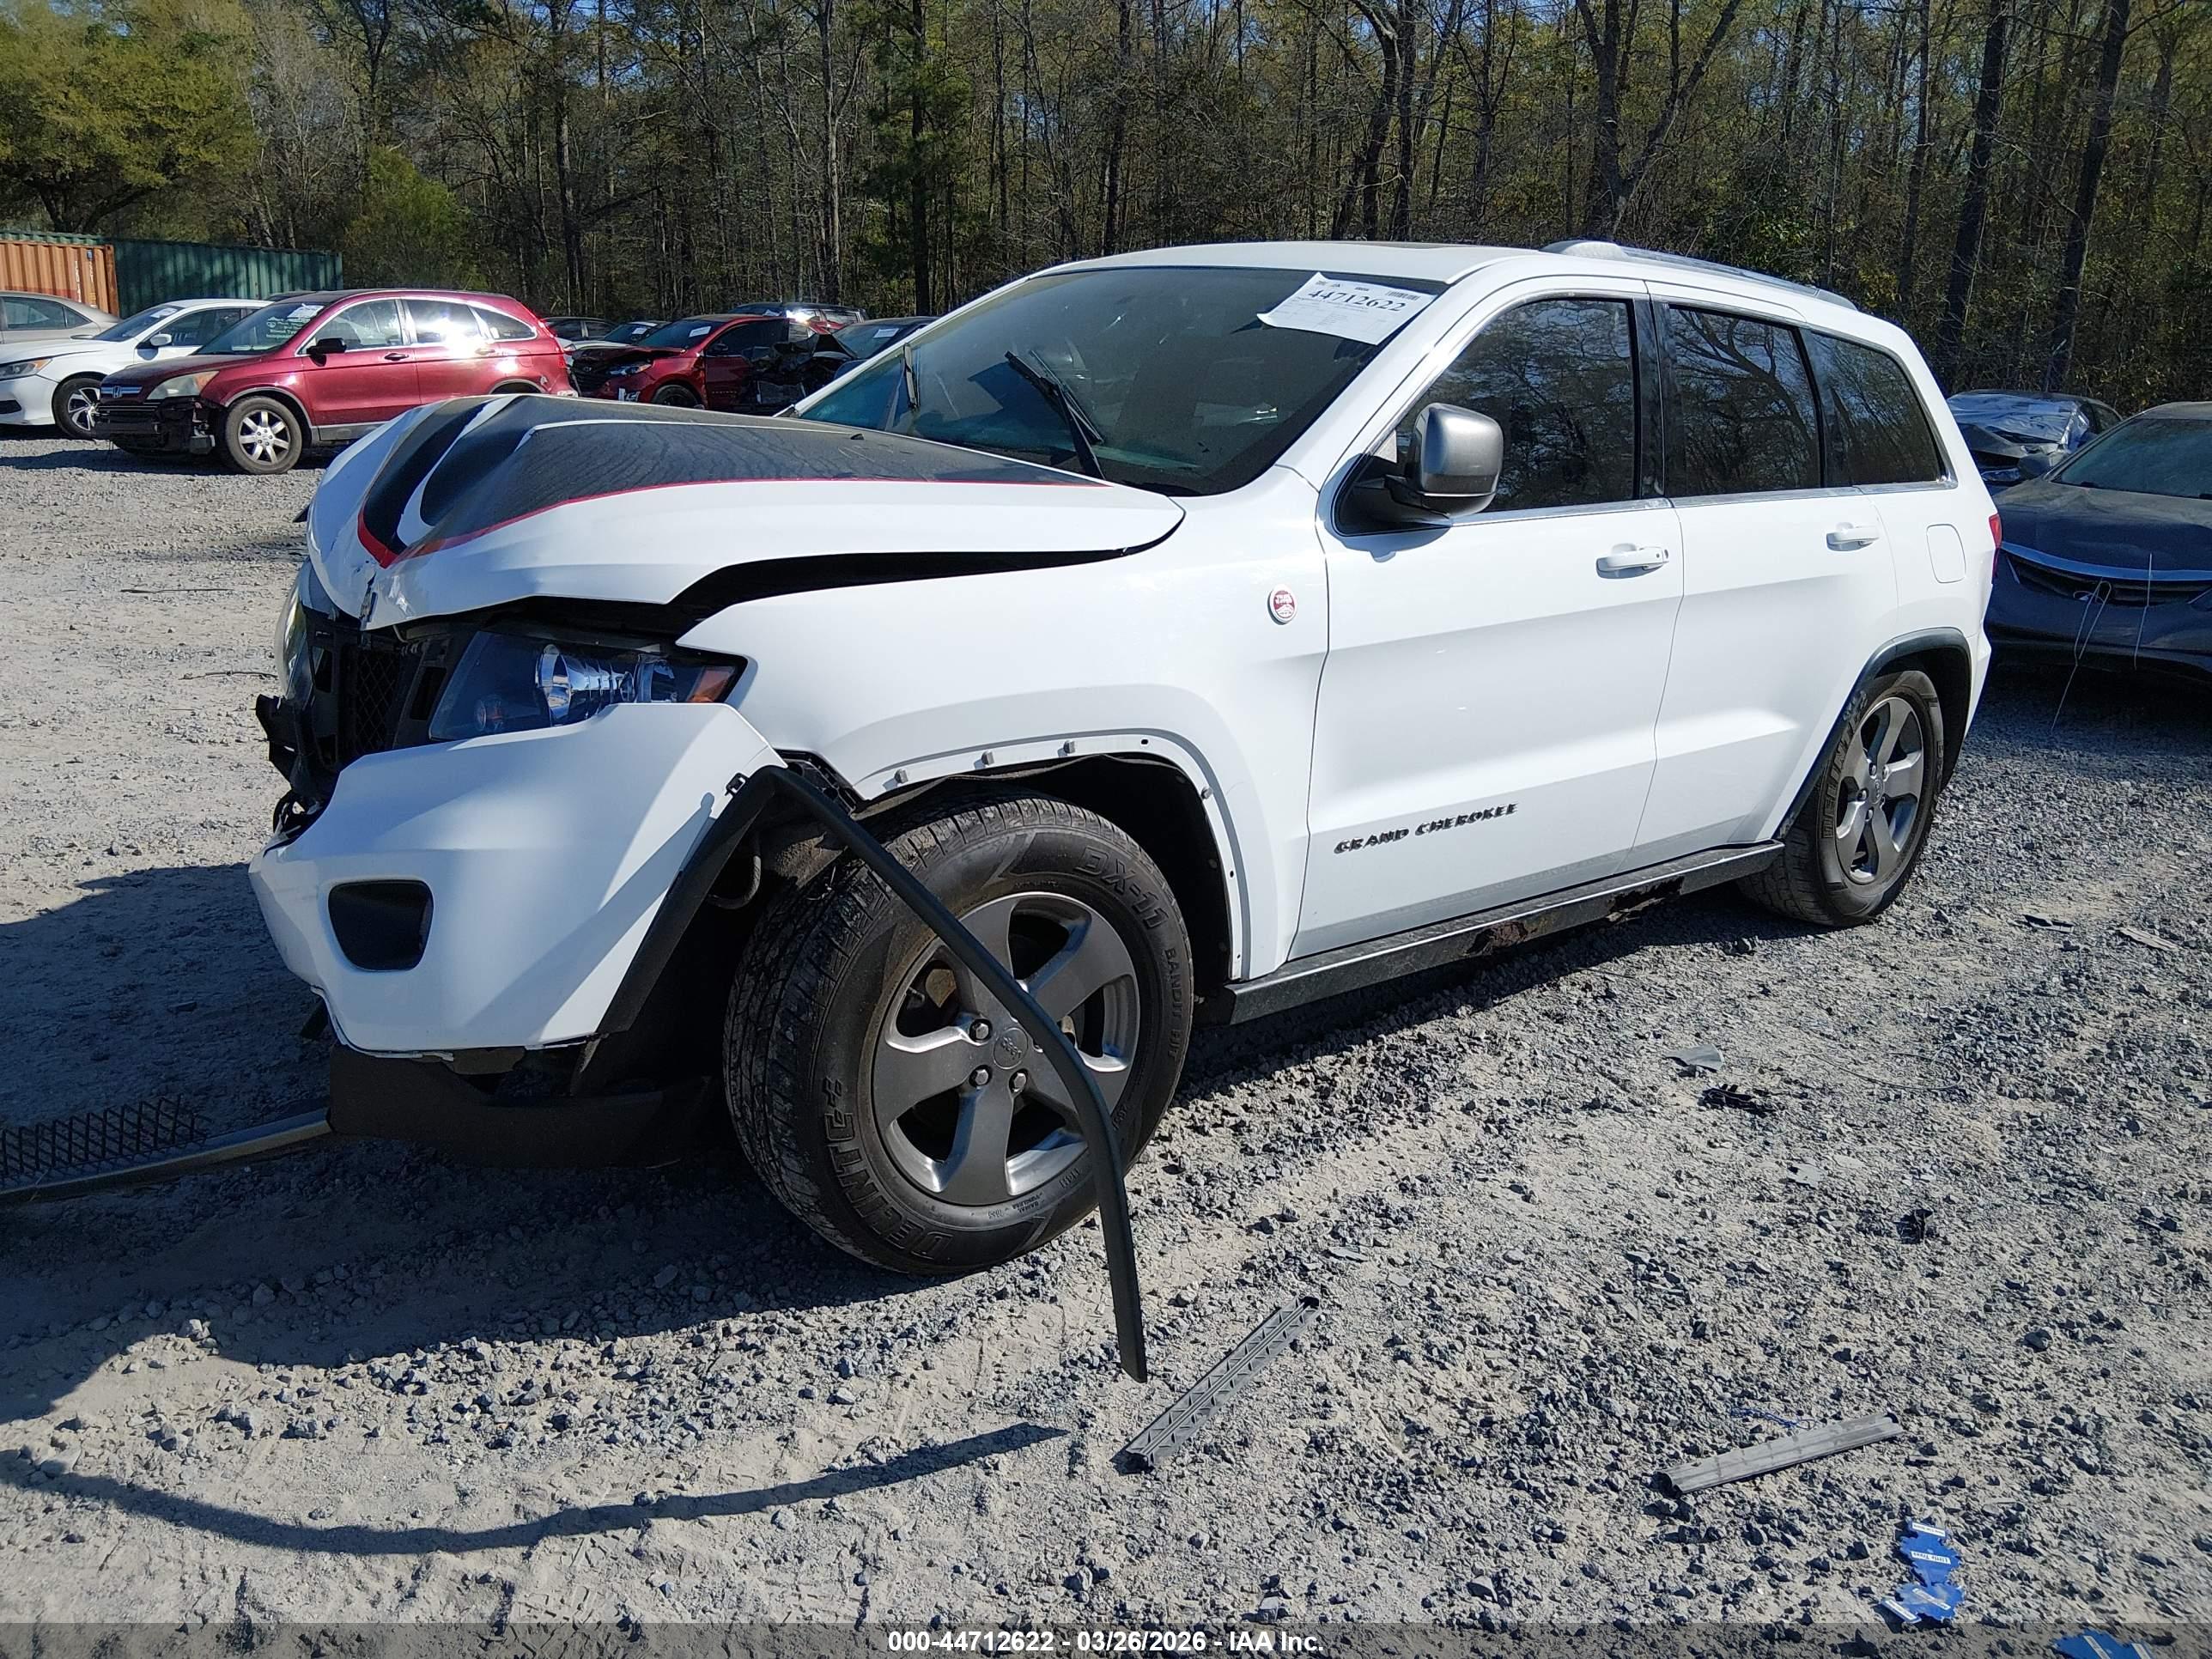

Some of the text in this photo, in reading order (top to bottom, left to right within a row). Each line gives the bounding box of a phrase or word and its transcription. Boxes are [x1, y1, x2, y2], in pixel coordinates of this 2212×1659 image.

[1309, 289, 1406, 311] 44712622
[1334, 802, 1519, 854] GRAND CHEROKEE
[1073, 845, 1170, 930] DX-11
[1163, 948, 1182, 1017] BANDIT
